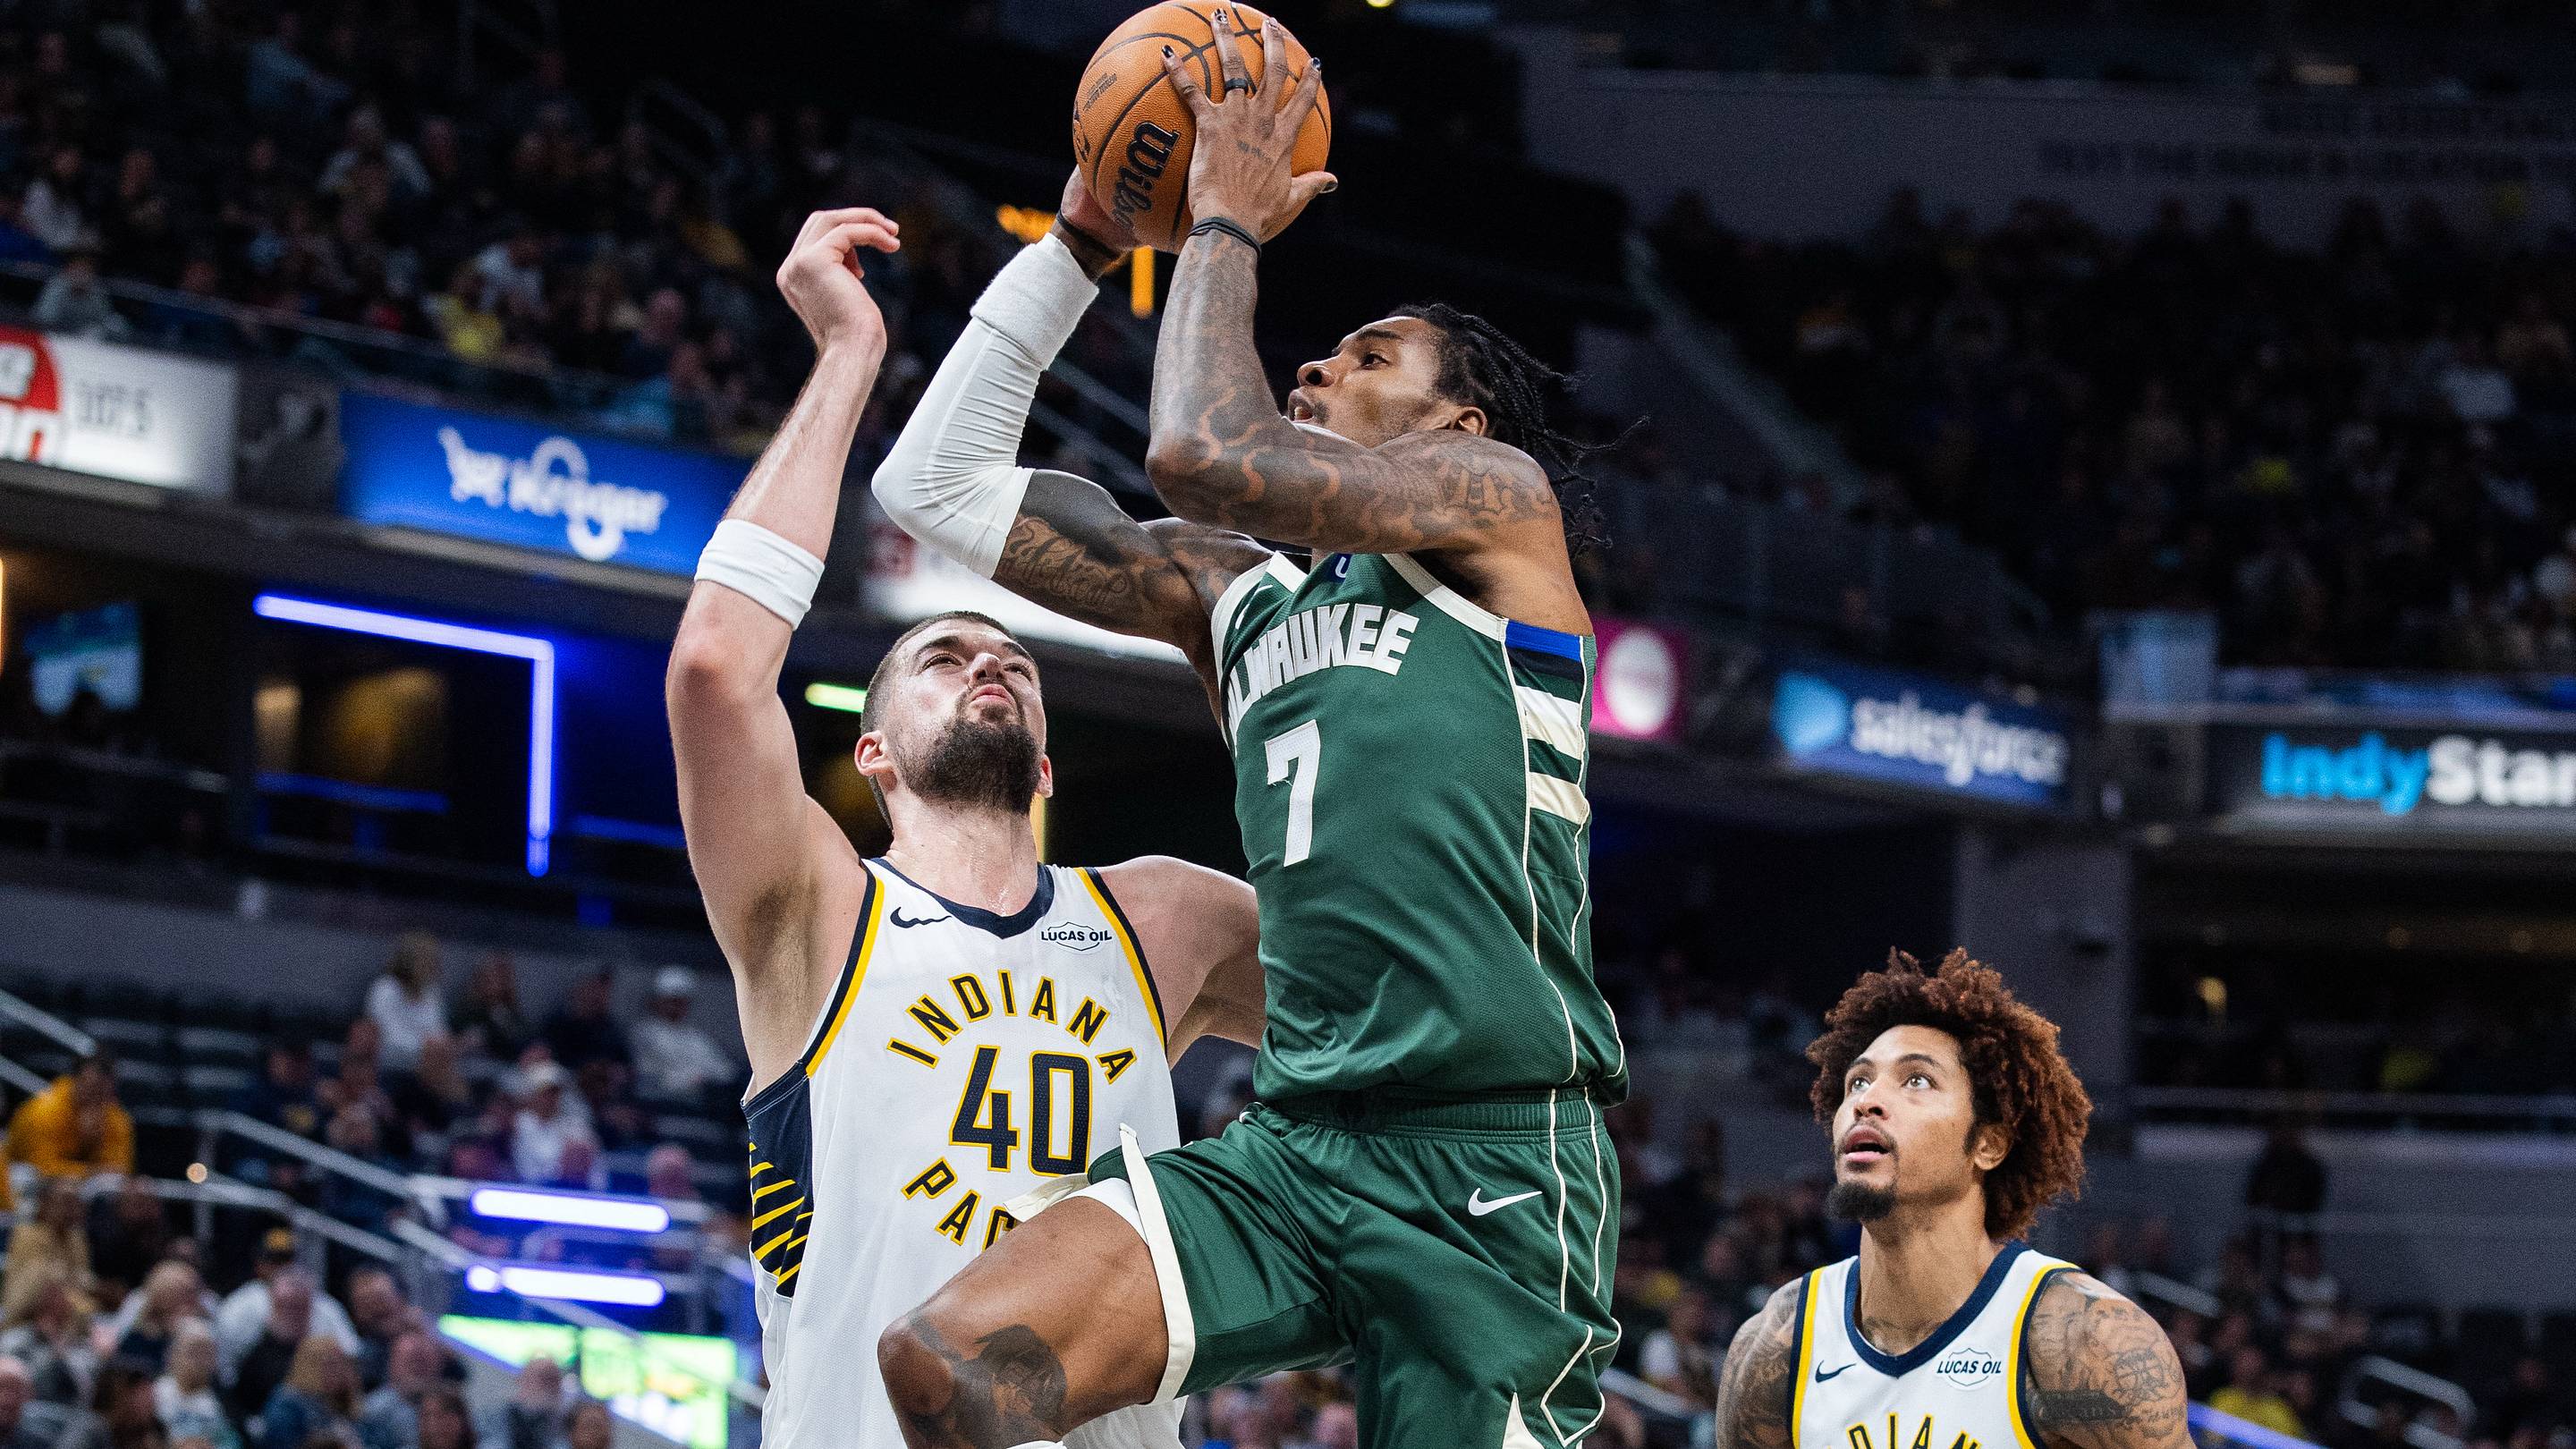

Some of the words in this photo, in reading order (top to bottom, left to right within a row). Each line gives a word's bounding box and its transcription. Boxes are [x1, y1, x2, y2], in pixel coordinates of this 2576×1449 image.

[1852, 691, 2066, 787] salesforce
[1264, 718, 1321, 868] 7
[1040, 930, 1085, 942] LUCAS
[1089, 929, 1113, 942] OIL
[886, 969, 1137, 1085] INDIANA
[948, 1044, 1092, 1178] 40
[1936, 1360, 1979, 1374] LUCAS
[1981, 1360, 2002, 1374] OIL
